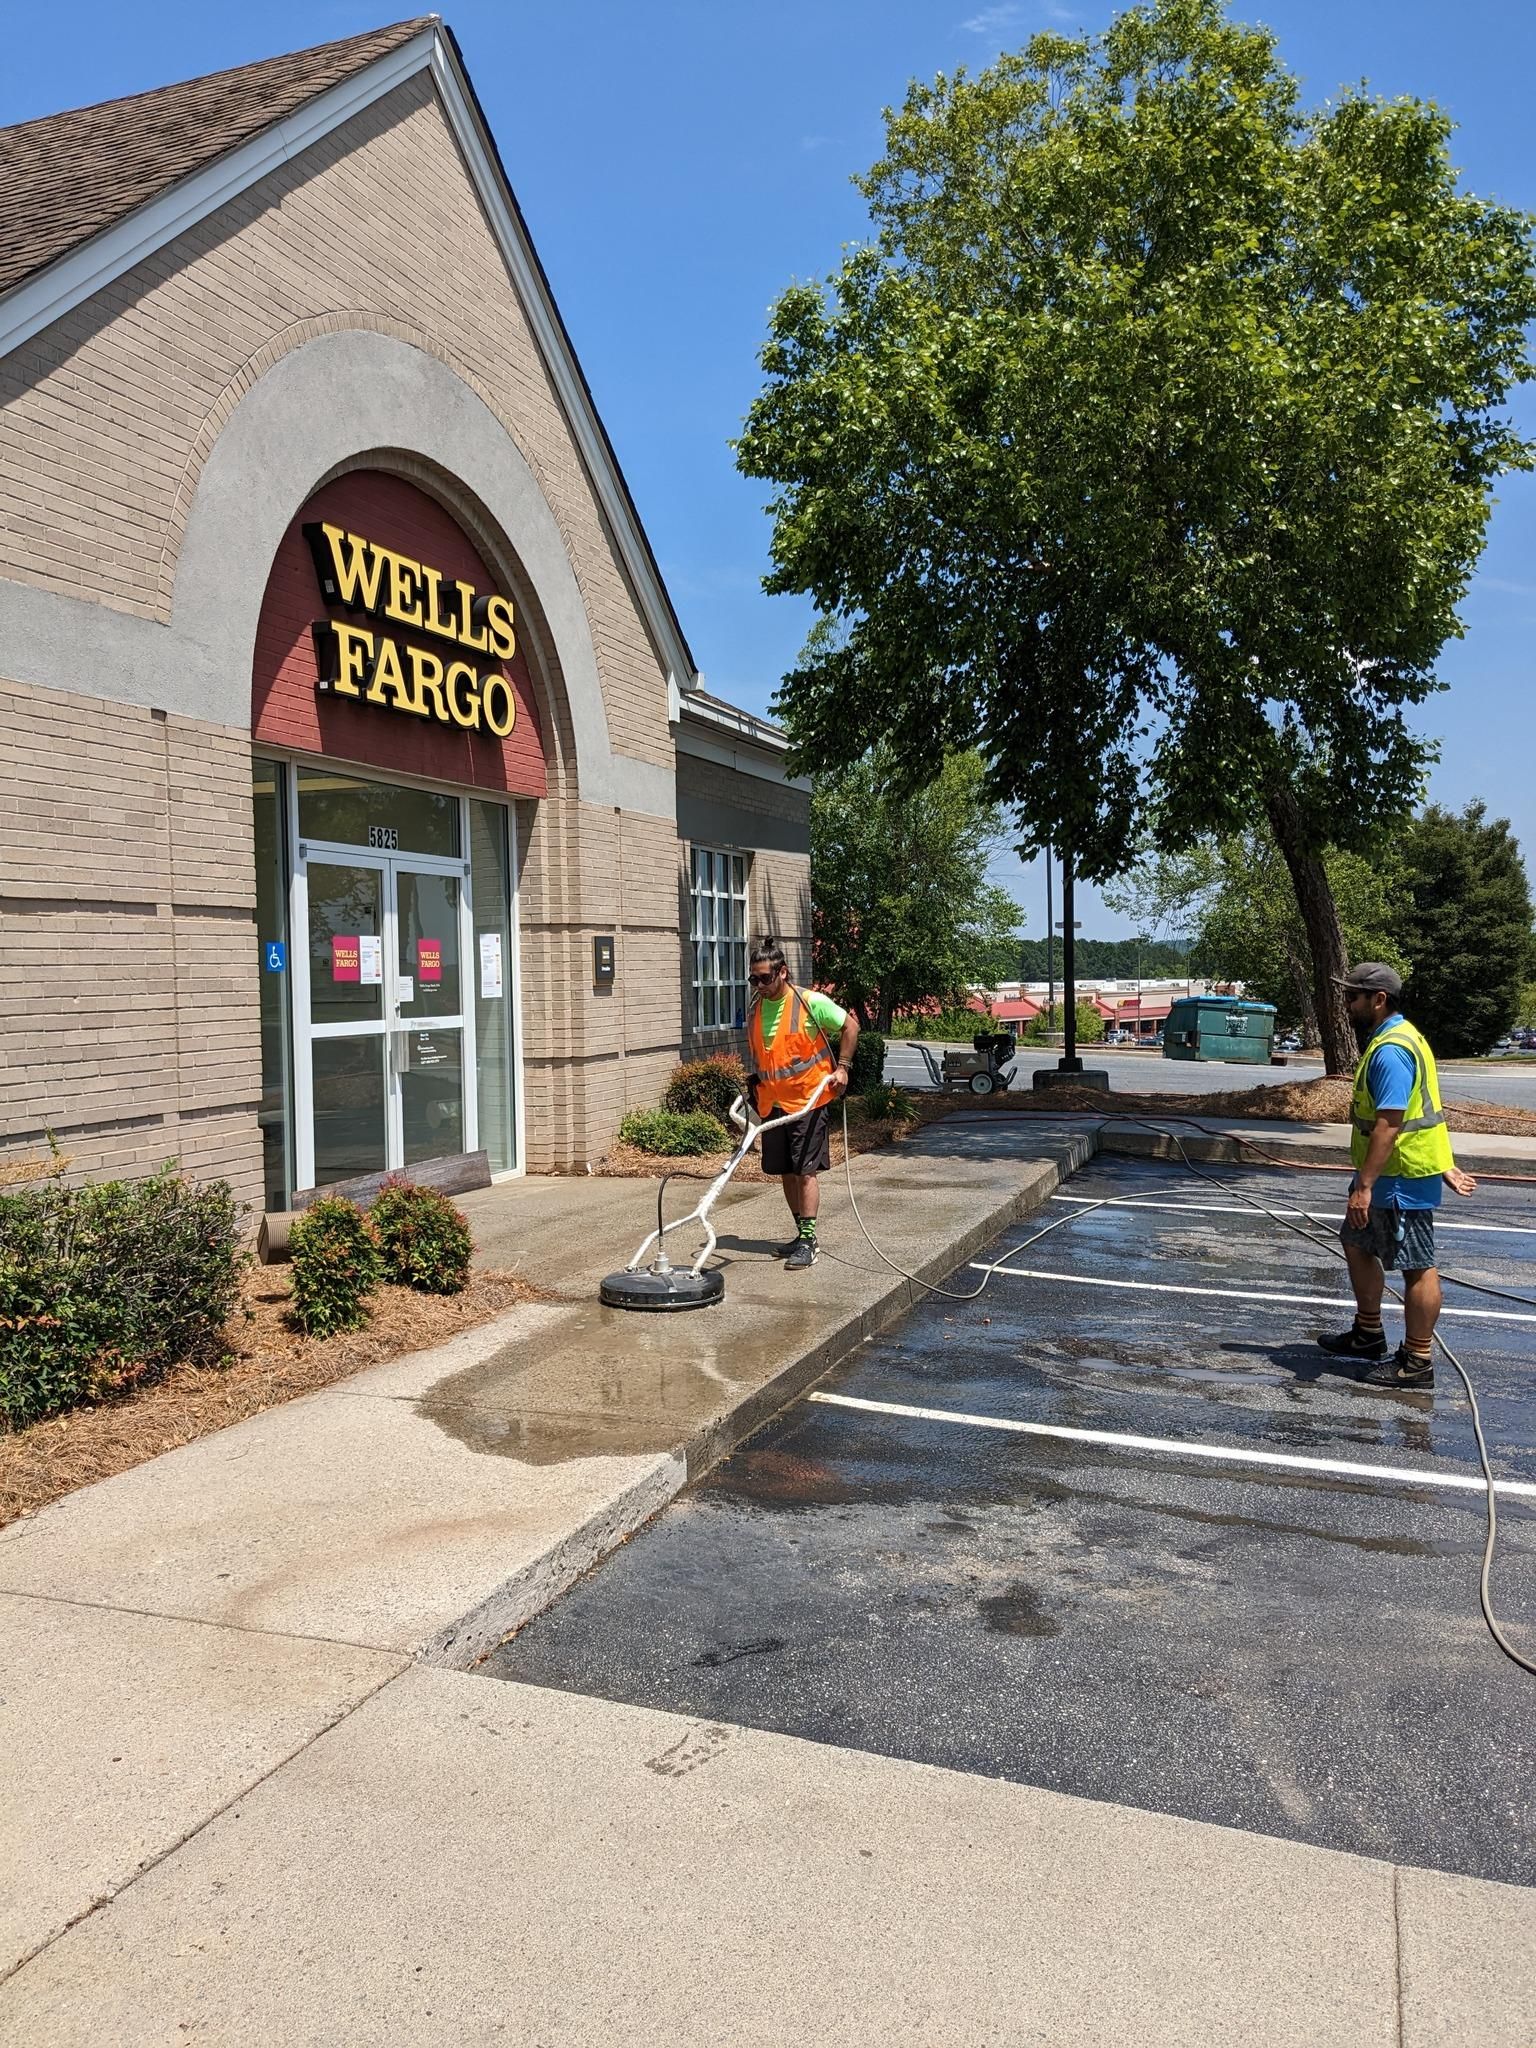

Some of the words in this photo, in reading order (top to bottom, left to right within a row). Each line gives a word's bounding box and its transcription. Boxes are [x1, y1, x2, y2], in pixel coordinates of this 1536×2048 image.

[322, 521, 516, 660] WELLS
[331, 620, 516, 737] FARGO
[370, 827, 397, 850] 5825
[335, 949, 358, 958] WELLS
[420, 951, 440, 960] WELLS
[335, 959, 358, 968] FARGO
[420, 960, 440, 968] FARGO
